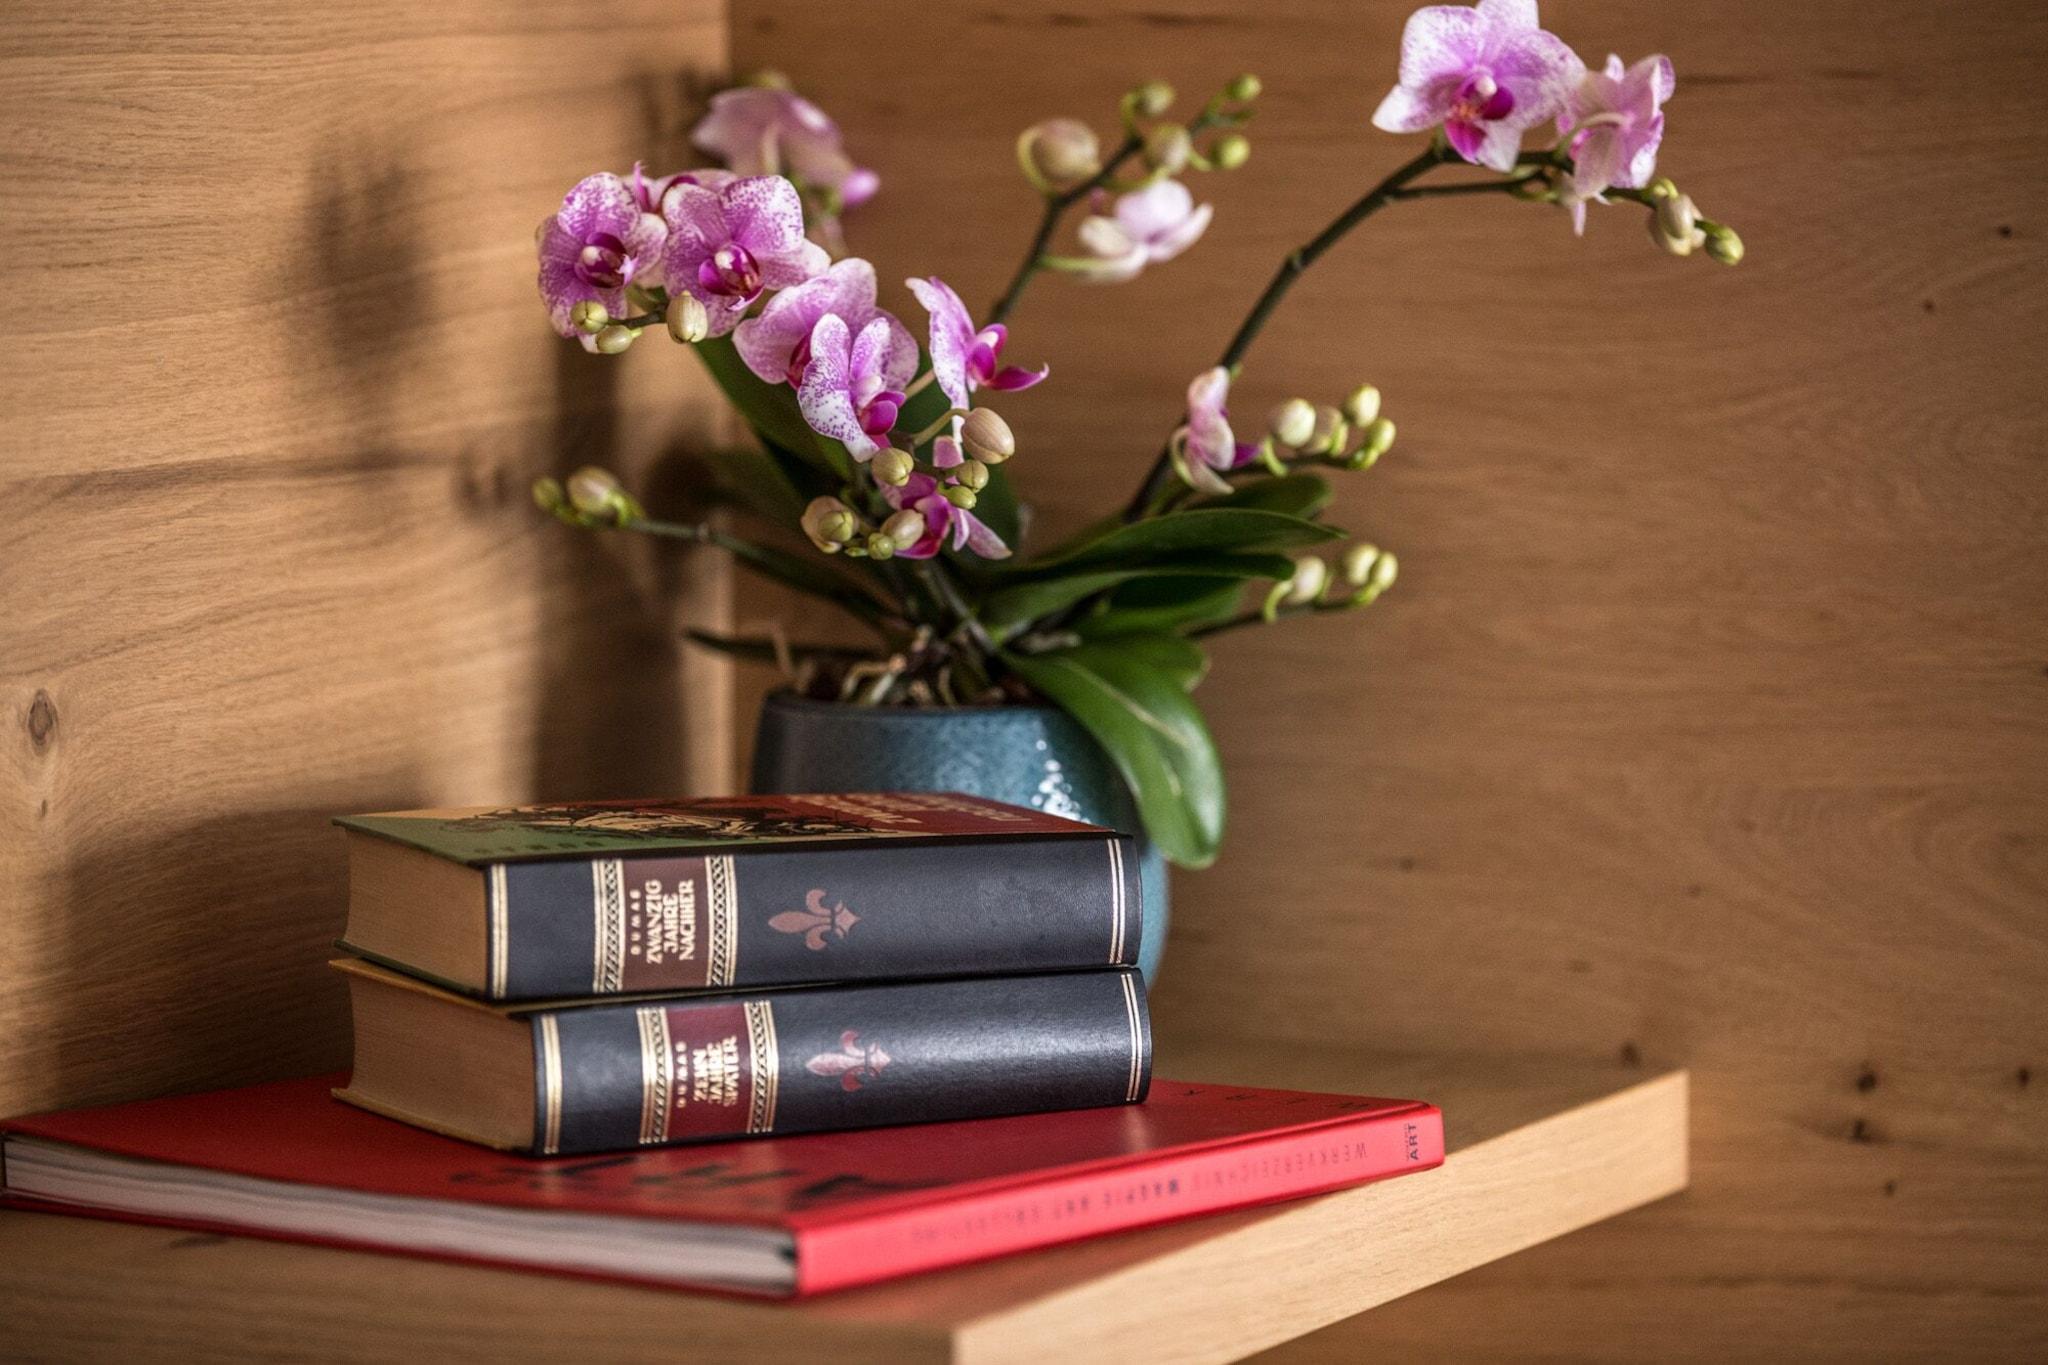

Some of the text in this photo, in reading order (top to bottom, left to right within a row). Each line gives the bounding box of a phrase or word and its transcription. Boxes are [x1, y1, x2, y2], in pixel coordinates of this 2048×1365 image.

[645, 879, 662, 964] ZWANZIG
[663, 893, 679, 953] JAHRE
[679, 879, 696, 960] NACHHER
[1408, 1123, 1418, 1160] ART
